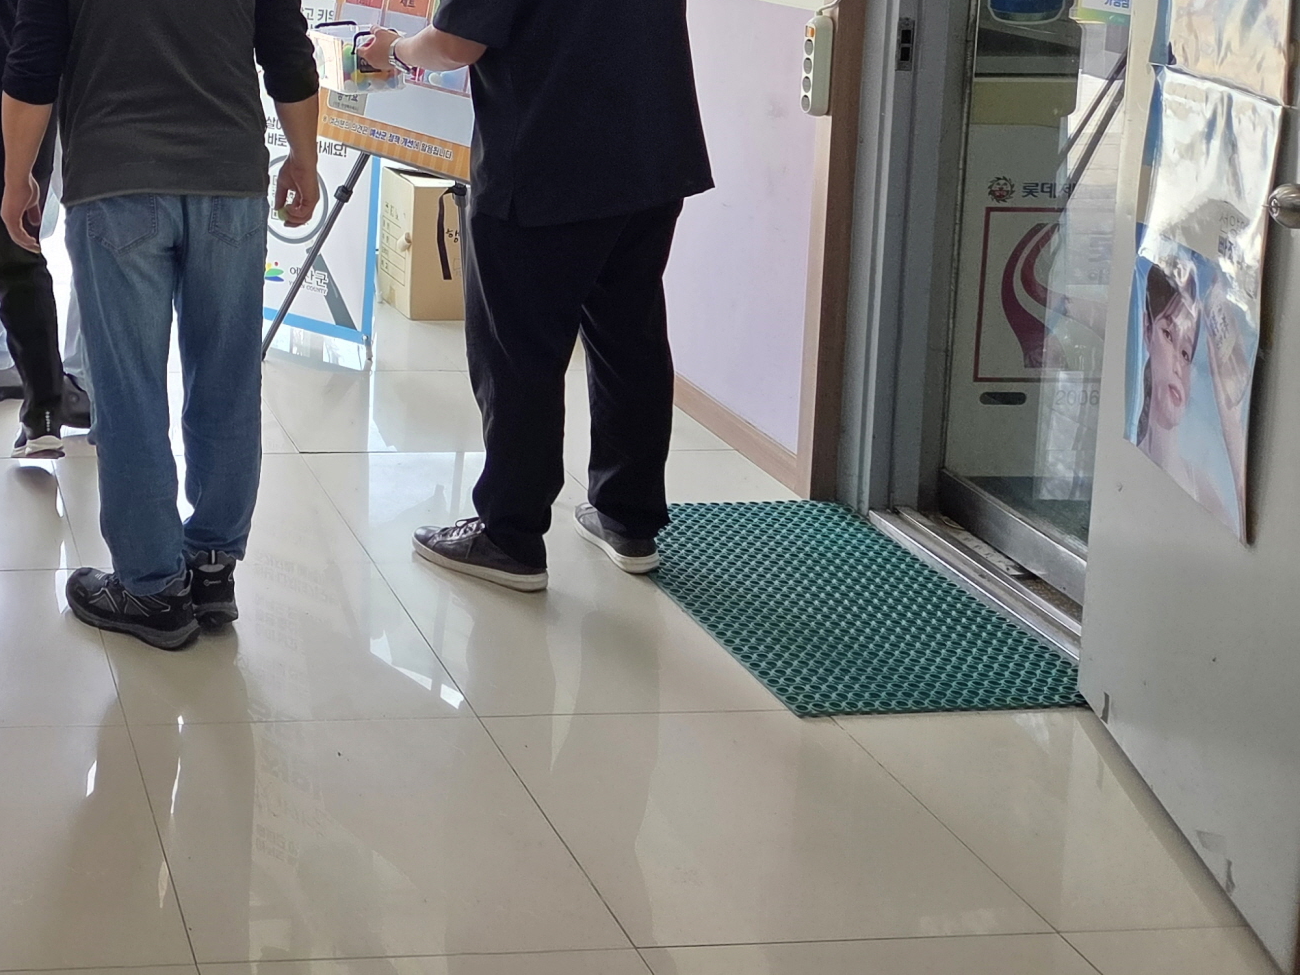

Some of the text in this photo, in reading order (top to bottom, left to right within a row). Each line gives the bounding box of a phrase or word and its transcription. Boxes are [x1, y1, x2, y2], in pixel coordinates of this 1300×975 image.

[267, 132, 287, 147] 바로
[369, 128, 387, 141] 예산군
[1055, 390, 1100, 406] 2006
